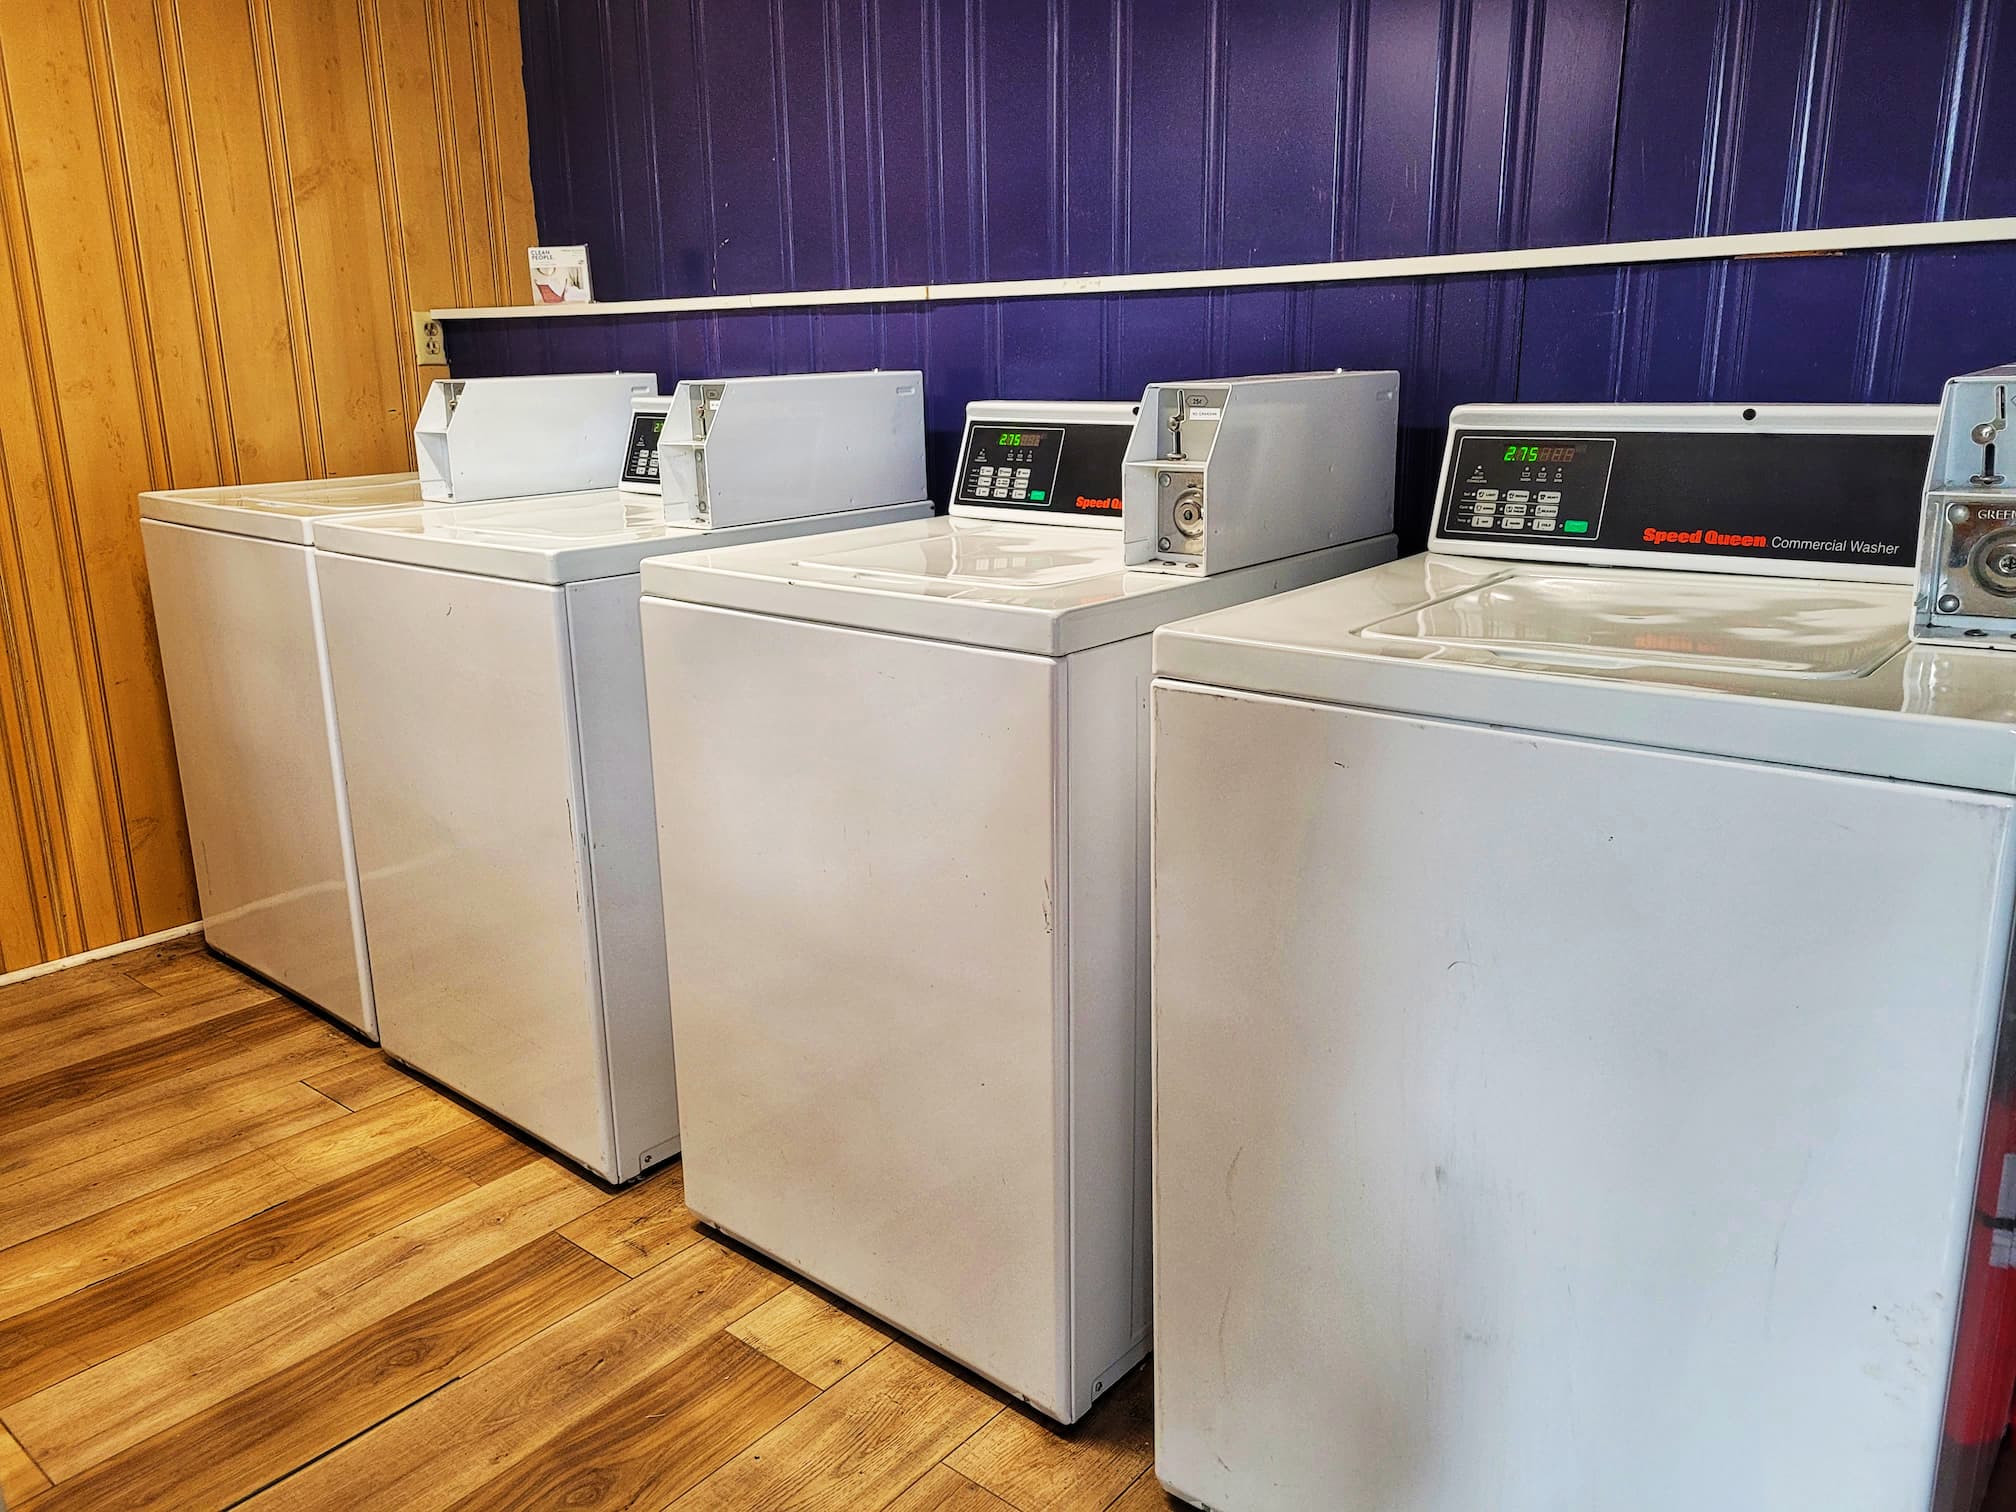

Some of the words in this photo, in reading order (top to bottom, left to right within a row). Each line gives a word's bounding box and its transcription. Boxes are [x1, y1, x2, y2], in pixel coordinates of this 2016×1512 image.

[1504, 446, 1539, 461] 2.75
[1076, 496, 1110, 509] Speed
[1643, 527, 1703, 544] Speed
[1704, 529, 1767, 548] Queen
[1771, 535, 1848, 552] Commercial
[1850, 540, 1900, 555] Washer
